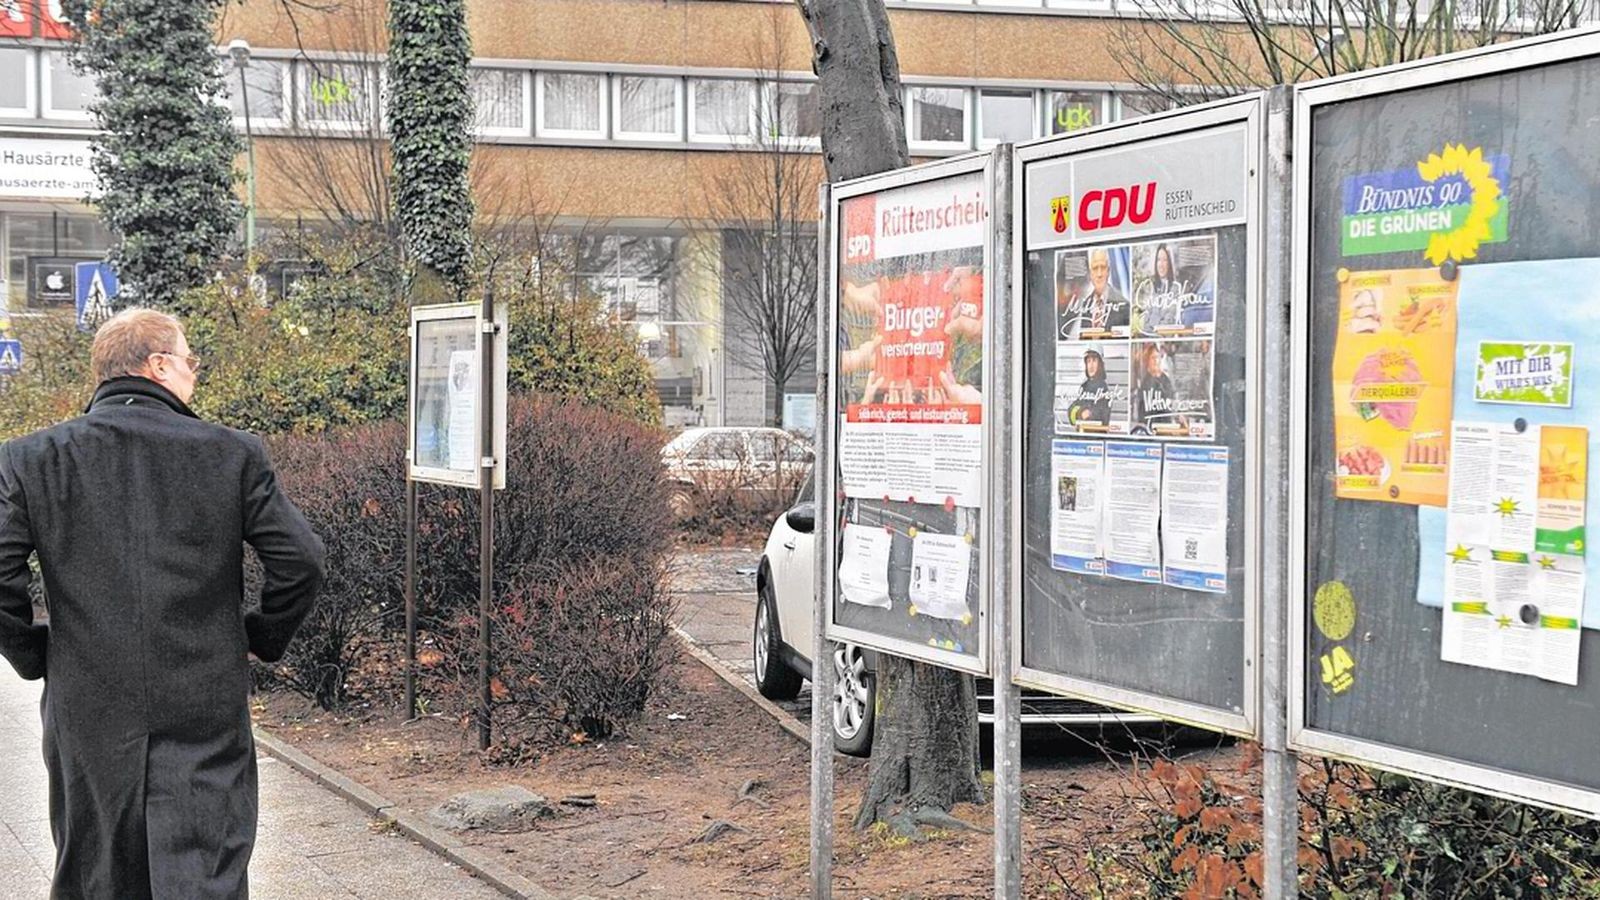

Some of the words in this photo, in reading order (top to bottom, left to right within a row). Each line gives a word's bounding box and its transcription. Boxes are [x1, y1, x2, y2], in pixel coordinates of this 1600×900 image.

[3, 150, 83, 167] Hausärzte
[1078, 182, 1157, 231] CDU
[1165, 190, 1193, 205] ESSEN
[1165, 199, 1236, 221] RÜTTENSCHEID
[1357, 184, 1434, 213] BÜNDNIS
[1439, 182, 1462, 211] 90
[1350, 217, 1376, 238] DIE
[1380, 210, 1452, 235] GRÜNEN
[847, 234, 872, 259] SPD
[884, 301, 944, 336] Bürger-
[1496, 359, 1523, 375] MIT
[1528, 356, 1552, 373] DIR
[1320, 646, 1354, 683] JA
